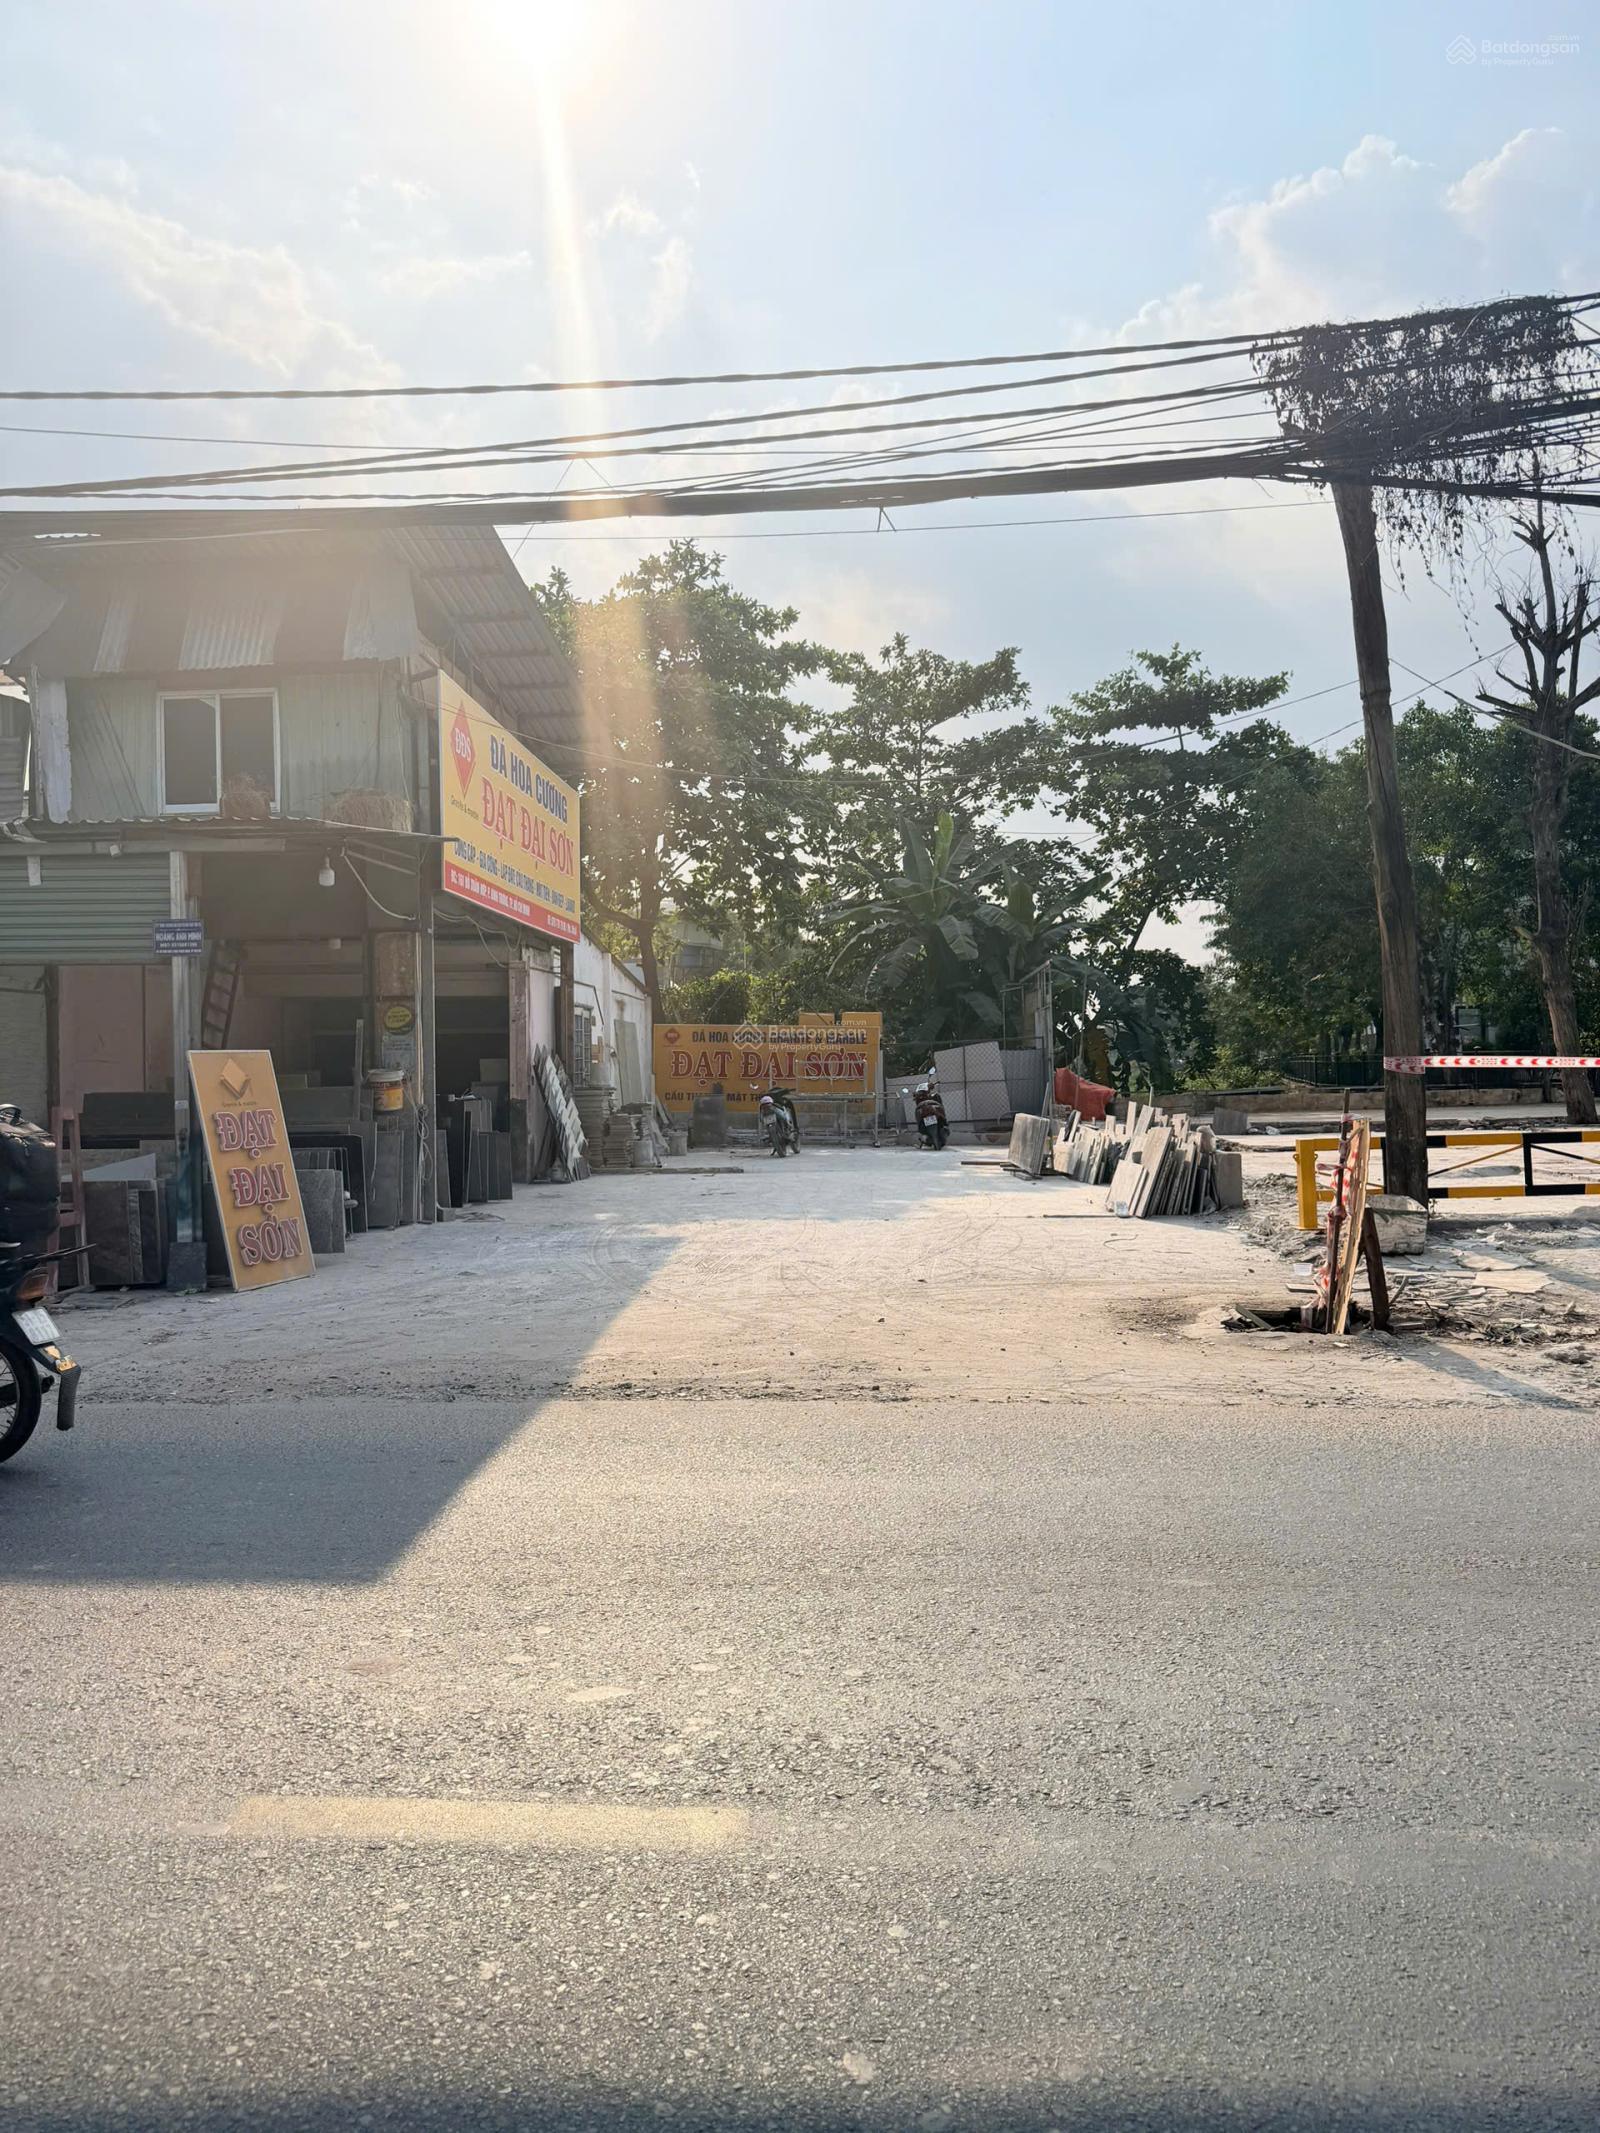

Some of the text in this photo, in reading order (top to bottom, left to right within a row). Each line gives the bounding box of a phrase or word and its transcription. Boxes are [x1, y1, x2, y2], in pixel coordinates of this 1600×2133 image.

[454, 727, 473, 762] ĐĐS
[490, 735, 568, 824] ĐÁ HOA CƯƠNG
[481, 776, 575, 878] ĐẠT ĐẠI SƠN
[692, 1029, 706, 1043] ĐÁ
[708, 1031, 729, 1043] HOA
[671, 1047, 868, 1087] ĐẠT ĐẠI SƠN
[214, 1109, 278, 1160] ĐẠT
[230, 1162, 291, 1214] ĐẠI
[239, 1215, 304, 1266] SƠN
